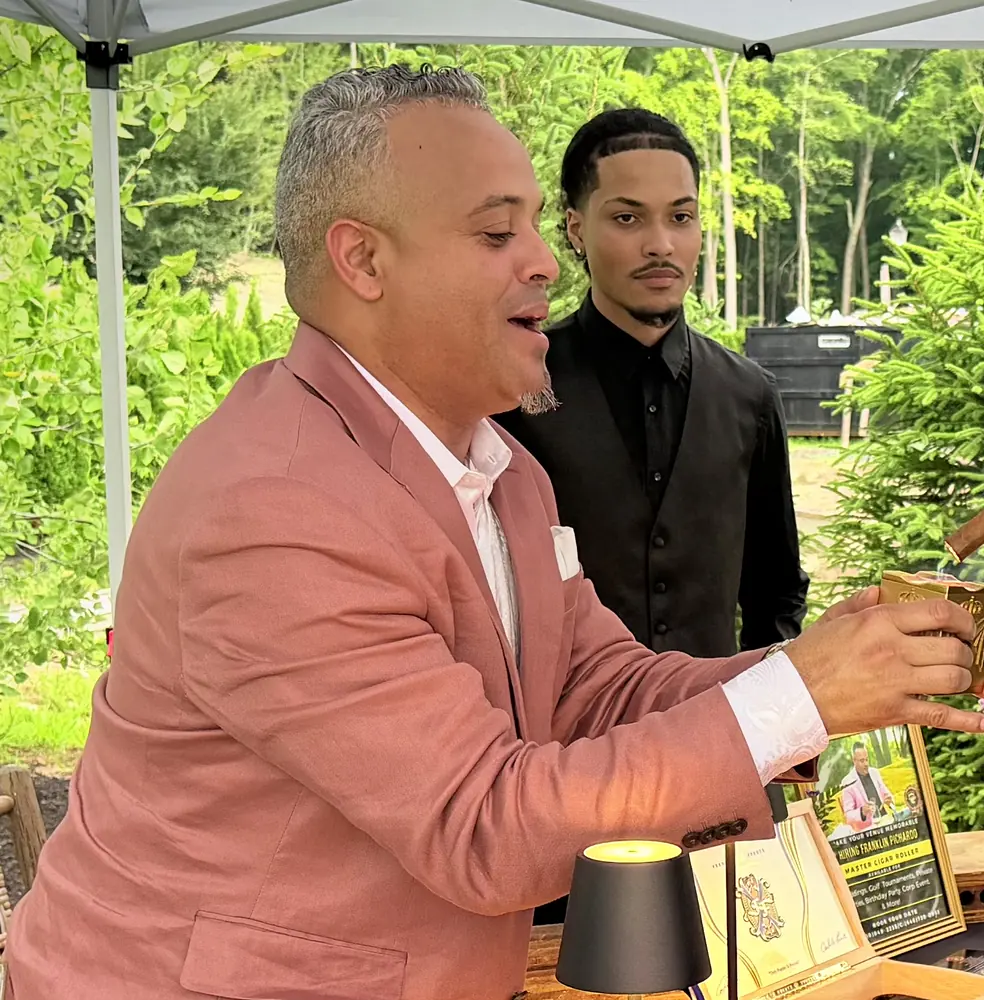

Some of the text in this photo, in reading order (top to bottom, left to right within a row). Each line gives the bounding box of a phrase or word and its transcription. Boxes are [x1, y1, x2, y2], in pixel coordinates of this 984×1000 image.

[849, 833, 865, 842] YOUR
[866, 828, 884, 838] VENUE
[885, 818, 919, 832] MEMORABLE
[838, 845, 860, 860] HIRING
[860, 836, 890, 854] FRANKLIN
[844, 847, 919, 875] MASTER CIGAR ROLLER
[865, 892, 888, 904] Birthday
[902, 883, 915, 893] Corp
[868, 882, 880, 892] Golf
[872, 908, 918, 928] BOOK YOUR DATE
